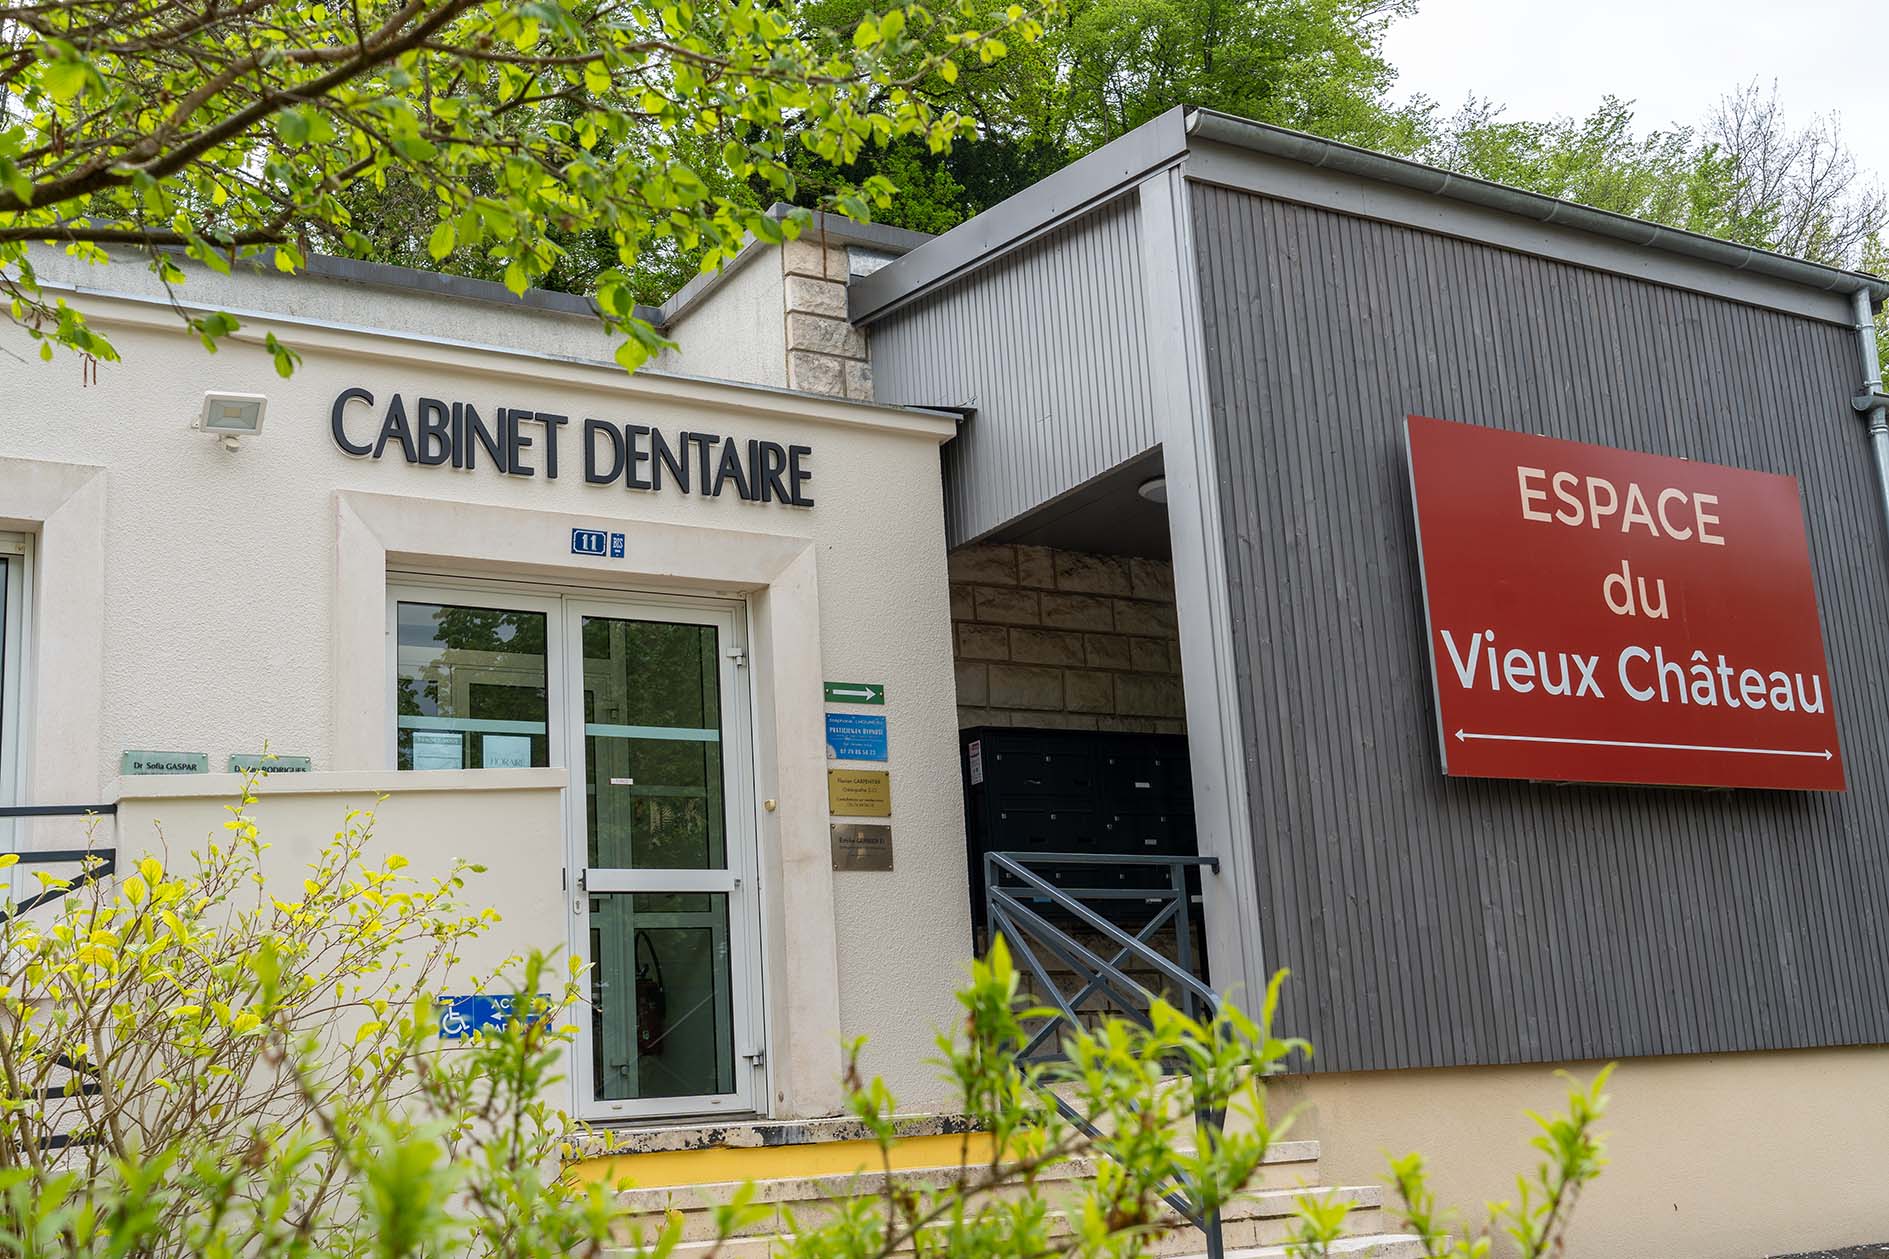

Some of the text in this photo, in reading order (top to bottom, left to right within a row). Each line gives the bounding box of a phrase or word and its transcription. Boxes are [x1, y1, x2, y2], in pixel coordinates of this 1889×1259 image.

[332, 387, 814, 507] CABINET DENTAIRE
[1517, 465, 1725, 546] ESPACE
[582, 533, 598, 551] 11
[1602, 559, 1670, 619] du
[1440, 628, 1825, 714] Vieux Château
[133, 761, 197, 771] Dr Sofia GASPAR
